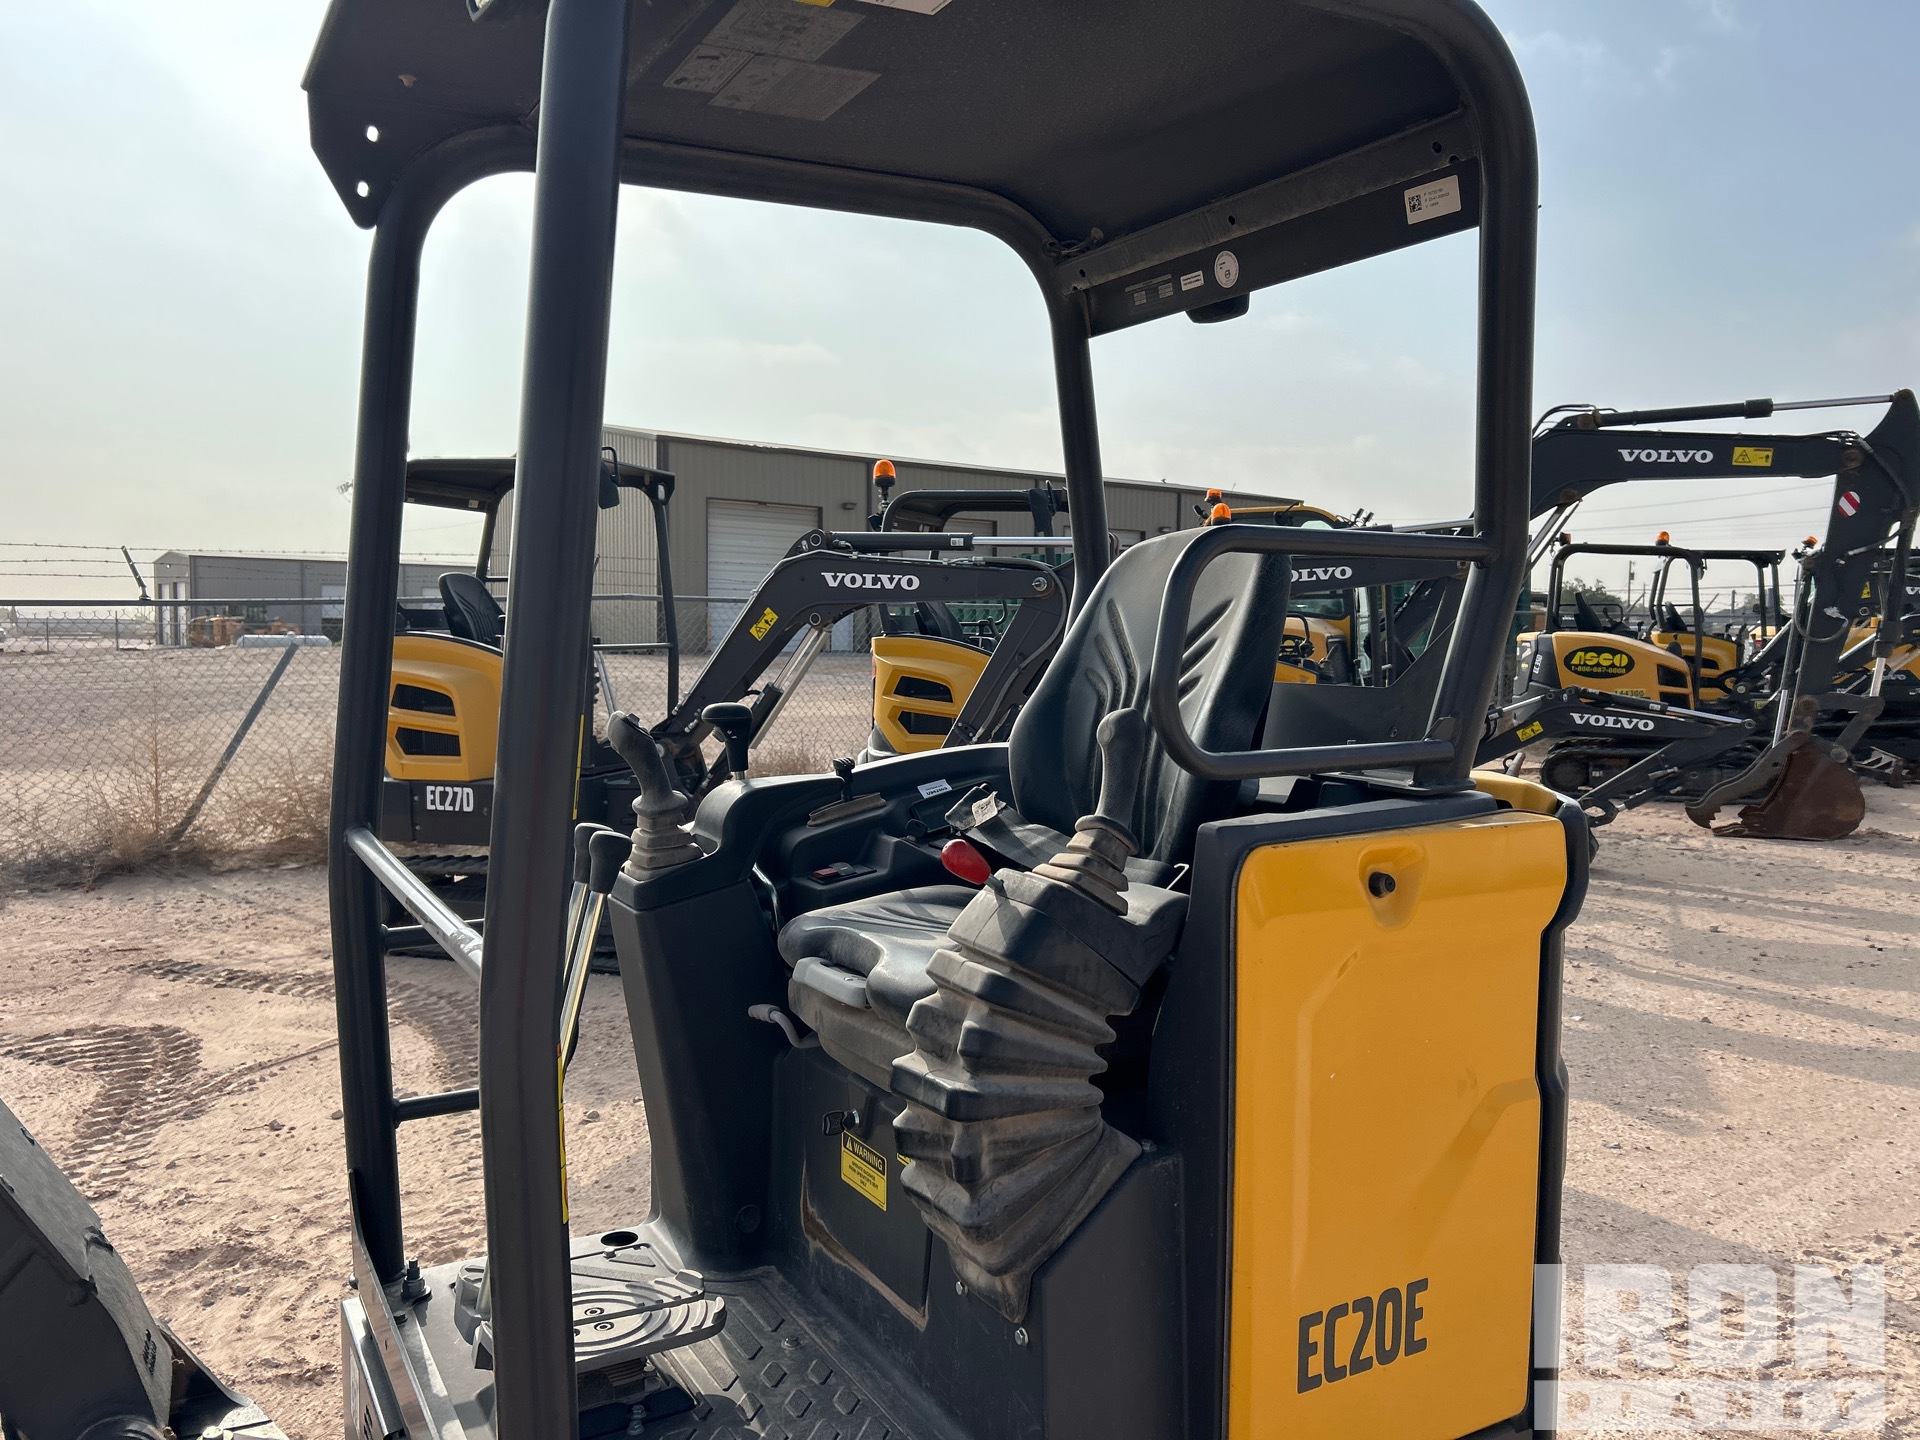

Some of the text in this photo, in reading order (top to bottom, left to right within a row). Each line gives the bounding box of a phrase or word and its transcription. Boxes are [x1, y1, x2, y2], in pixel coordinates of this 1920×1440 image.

[1618, 449, 1714, 464] VOLVO
[820, 572, 920, 591] VOLVO
[1291, 566, 1353, 583] LVO
[1571, 651, 1629, 667] ASCO
[1569, 712, 1655, 731] VOLVO
[426, 785, 474, 813] EC27D
[853, 1142, 883, 1171] WARNING
[1297, 1277, 1429, 1395] EC20E
